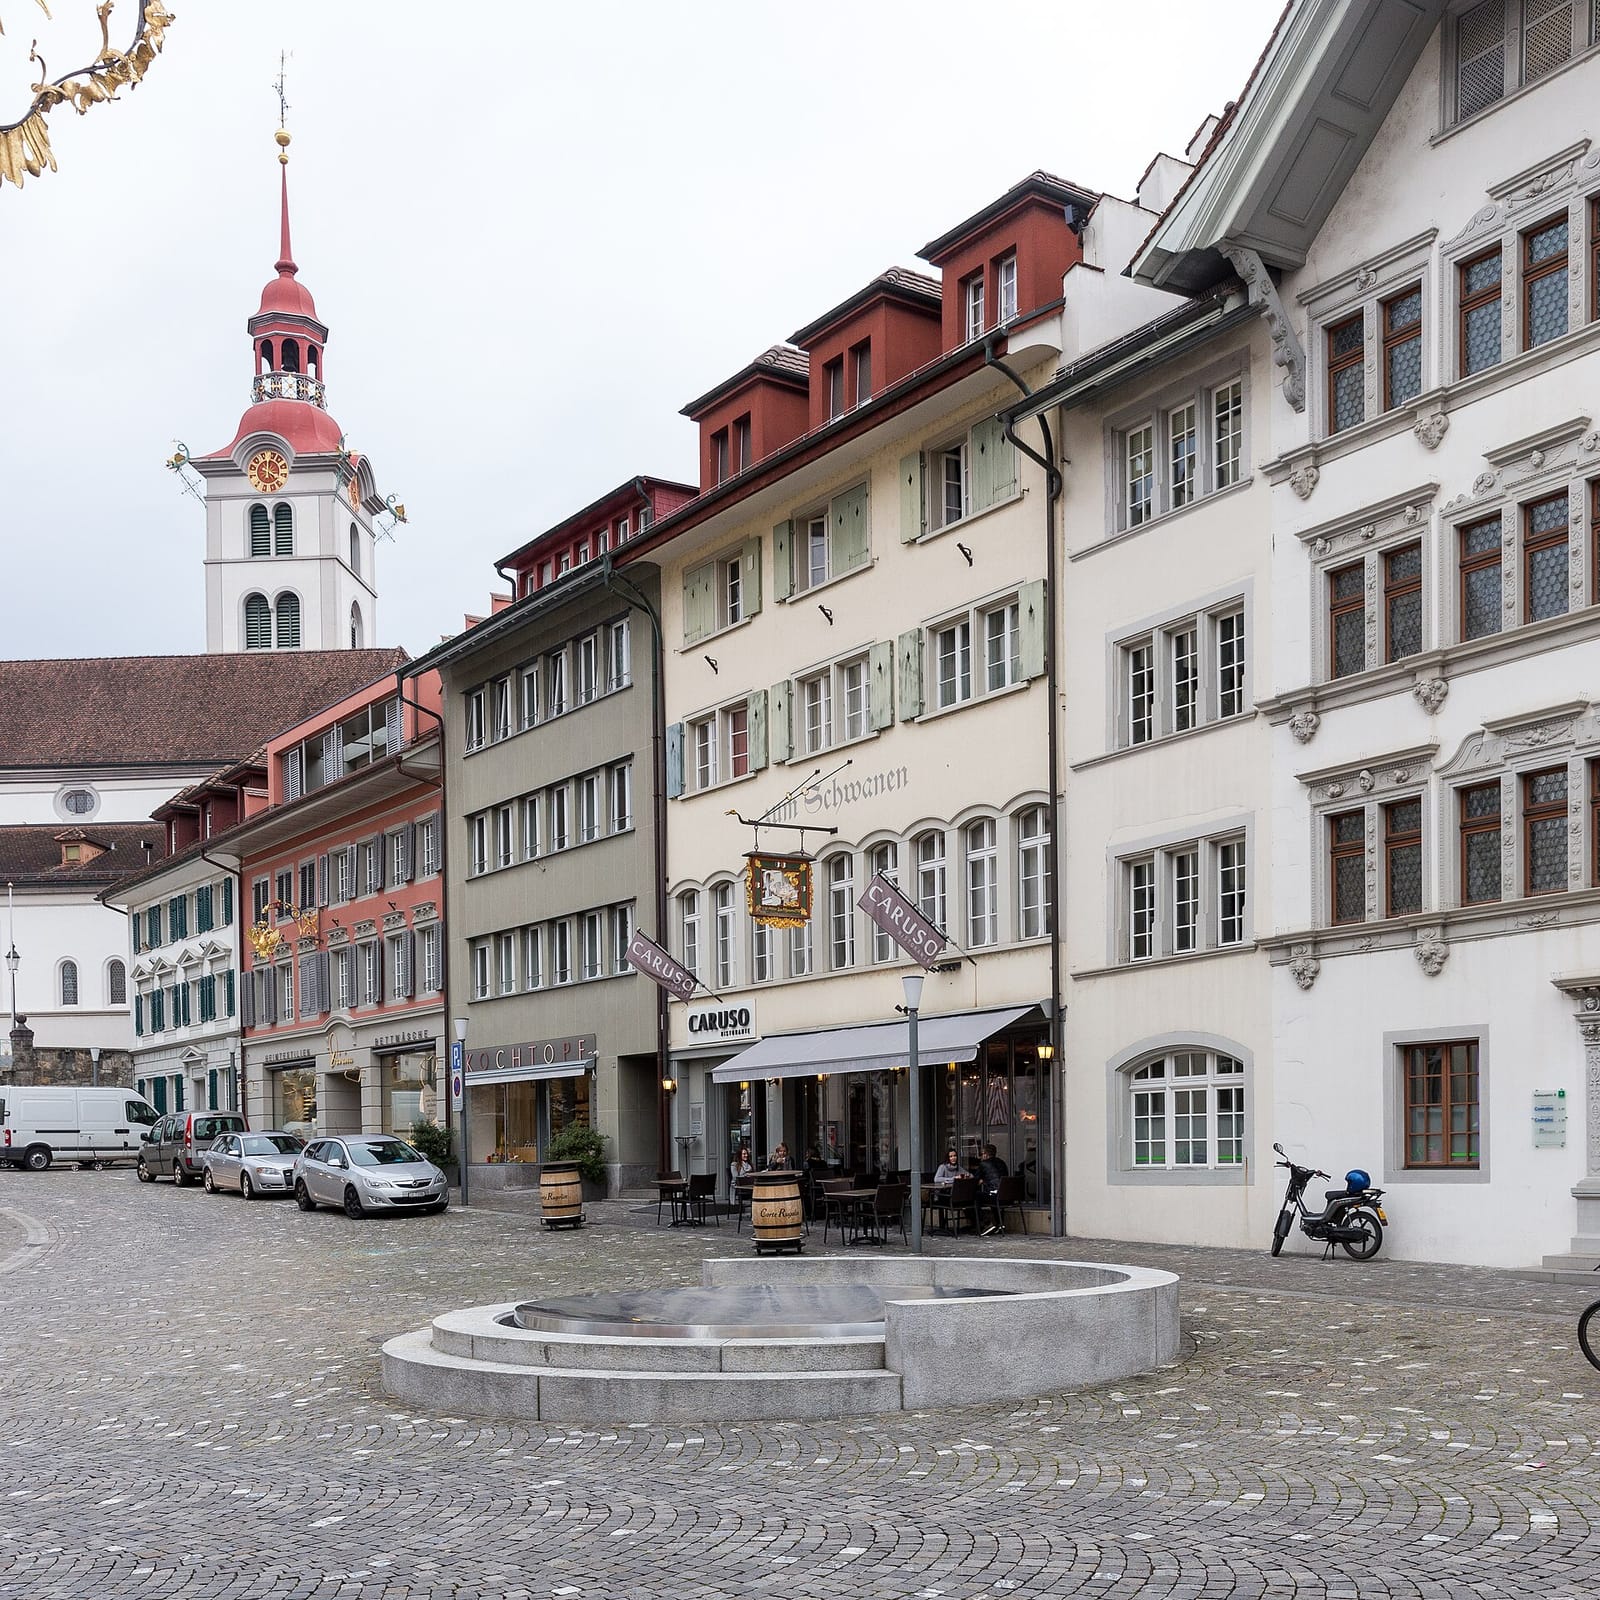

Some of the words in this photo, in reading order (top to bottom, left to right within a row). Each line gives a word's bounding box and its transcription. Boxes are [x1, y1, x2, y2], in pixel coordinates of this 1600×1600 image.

[804, 765, 909, 814] Schwanen
[868, 885, 938, 956] CARUSO
[632, 941, 694, 991] CARUSO
[688, 1008, 750, 1033] CARUSO
[720, 1028, 751, 1037] RISTORANTE
[465, 1039, 586, 1072] KOCHTOPF
